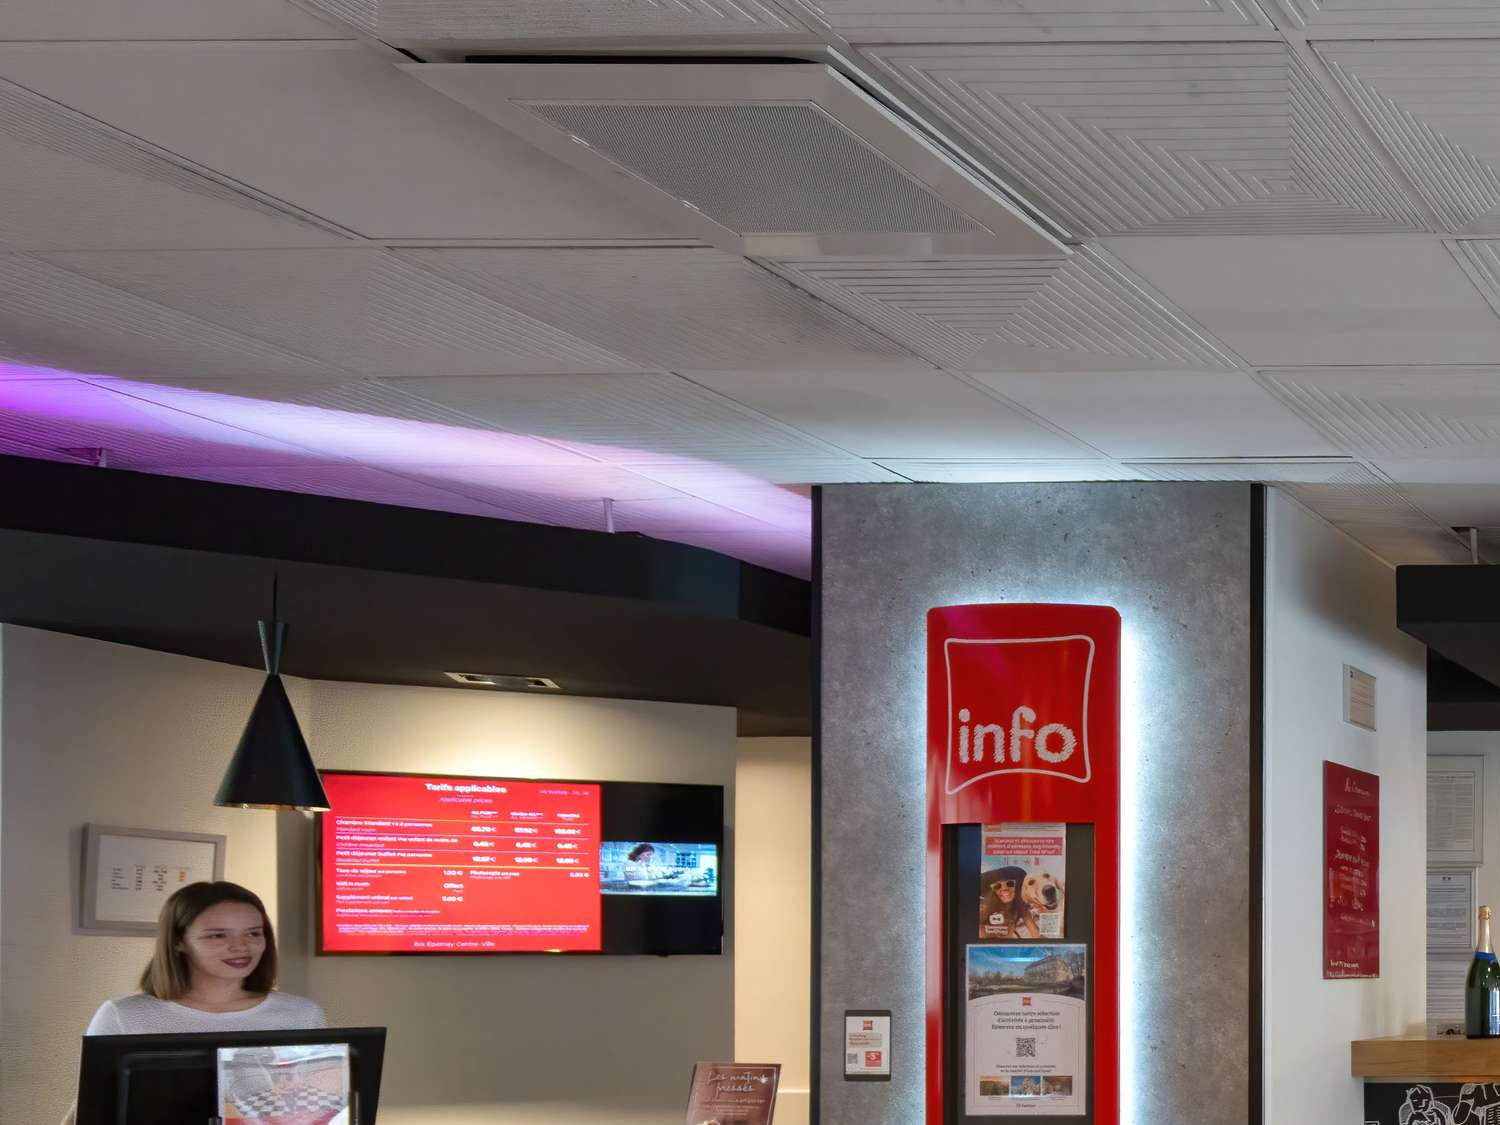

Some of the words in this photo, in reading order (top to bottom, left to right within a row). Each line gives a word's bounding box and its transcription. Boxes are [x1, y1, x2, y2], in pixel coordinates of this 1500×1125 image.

[958, 705, 1077, 763] info
[425, 783, 453, 791] Tarifs
[454, 784, 507, 795] applicables
